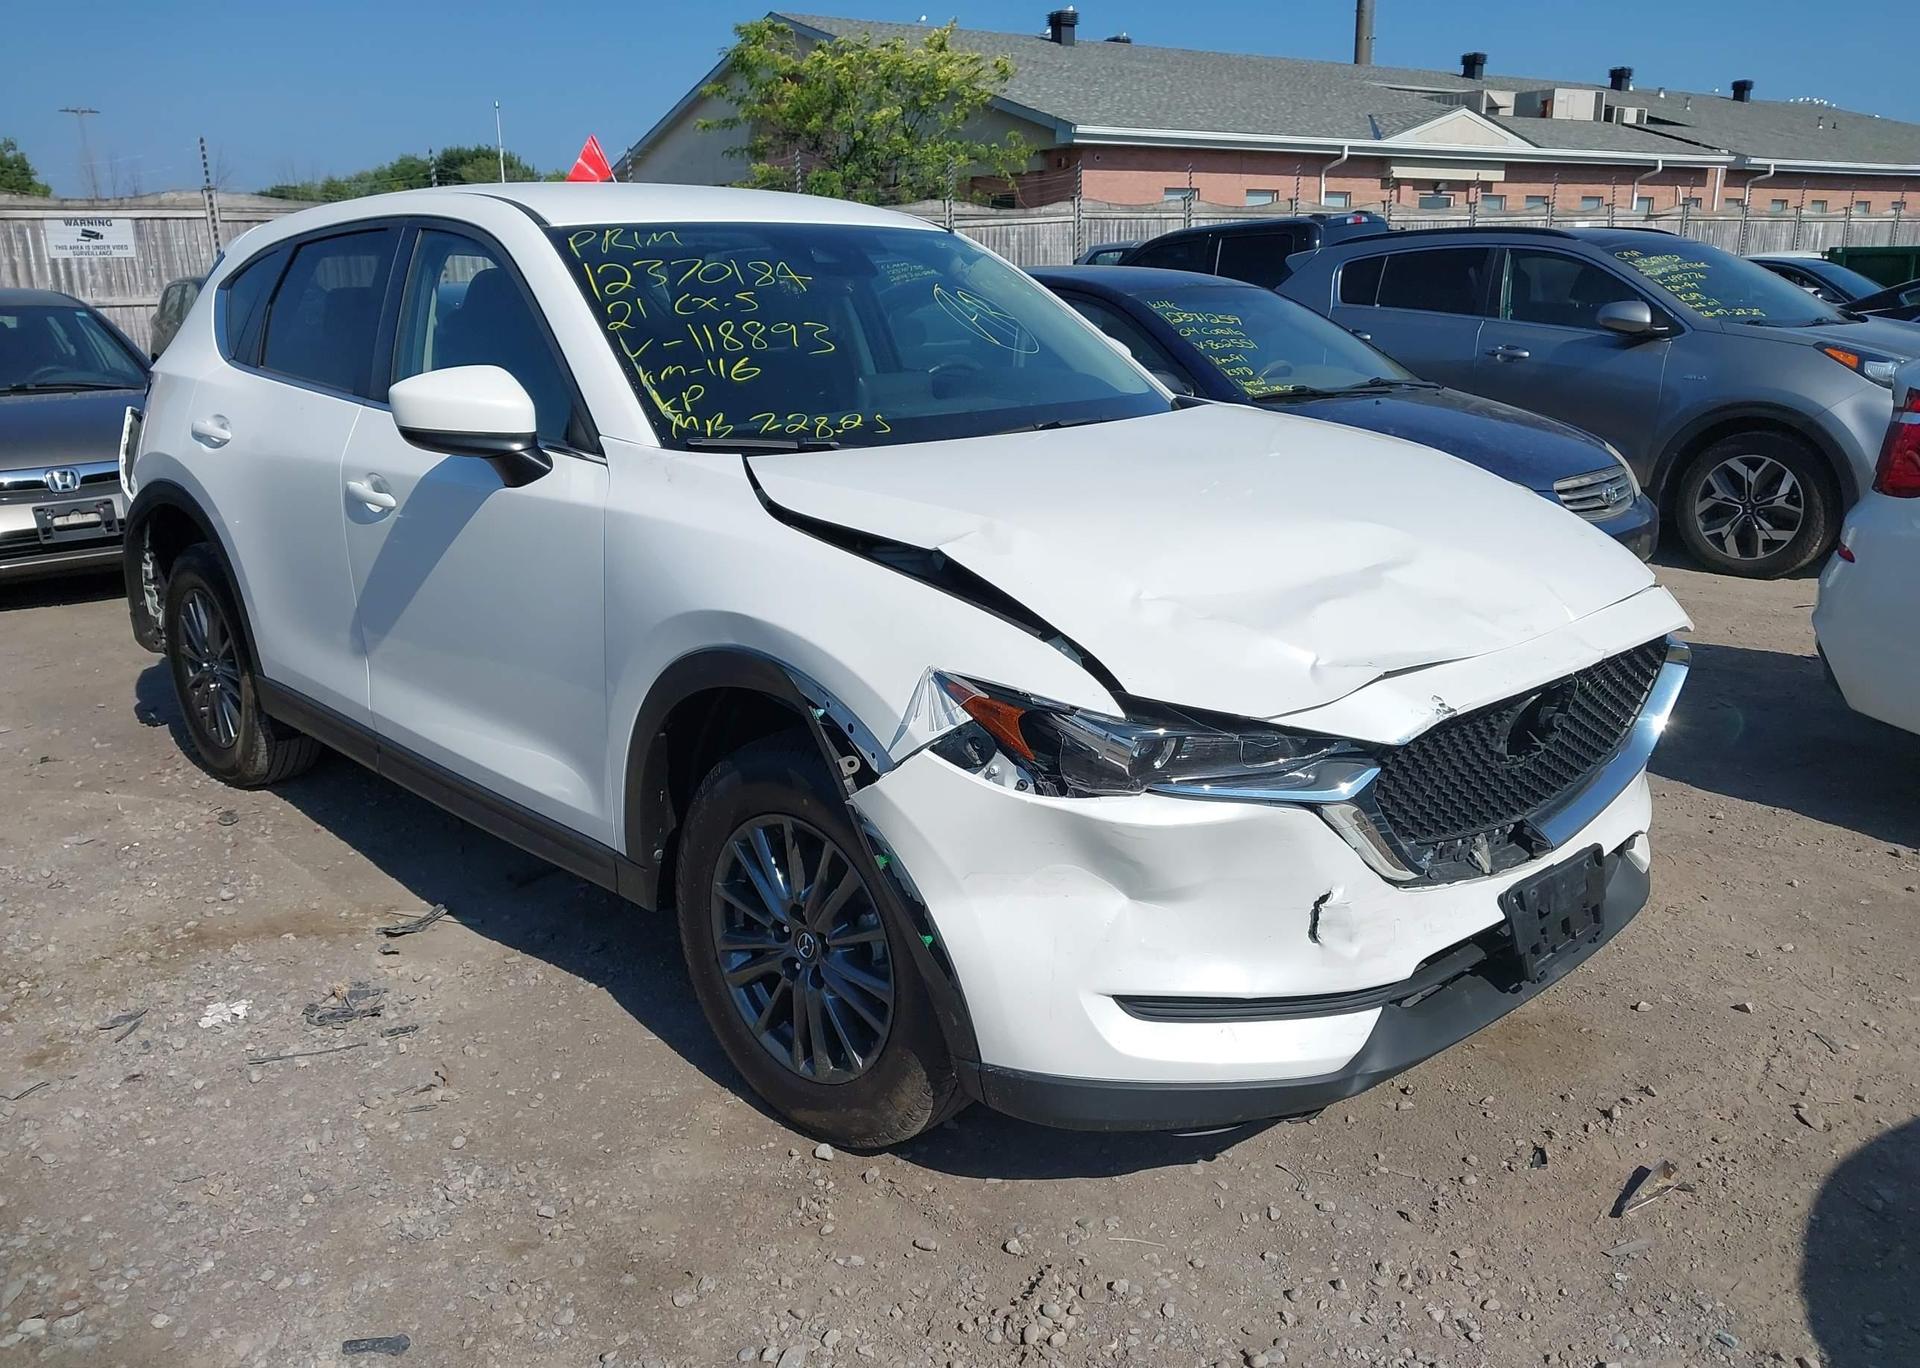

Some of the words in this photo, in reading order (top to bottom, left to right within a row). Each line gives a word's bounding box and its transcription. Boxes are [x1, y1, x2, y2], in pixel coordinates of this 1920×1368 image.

[63, 217, 113, 227] WARNING
[568, 228, 683, 257] PRIM
[607, 297, 648, 330] 21
